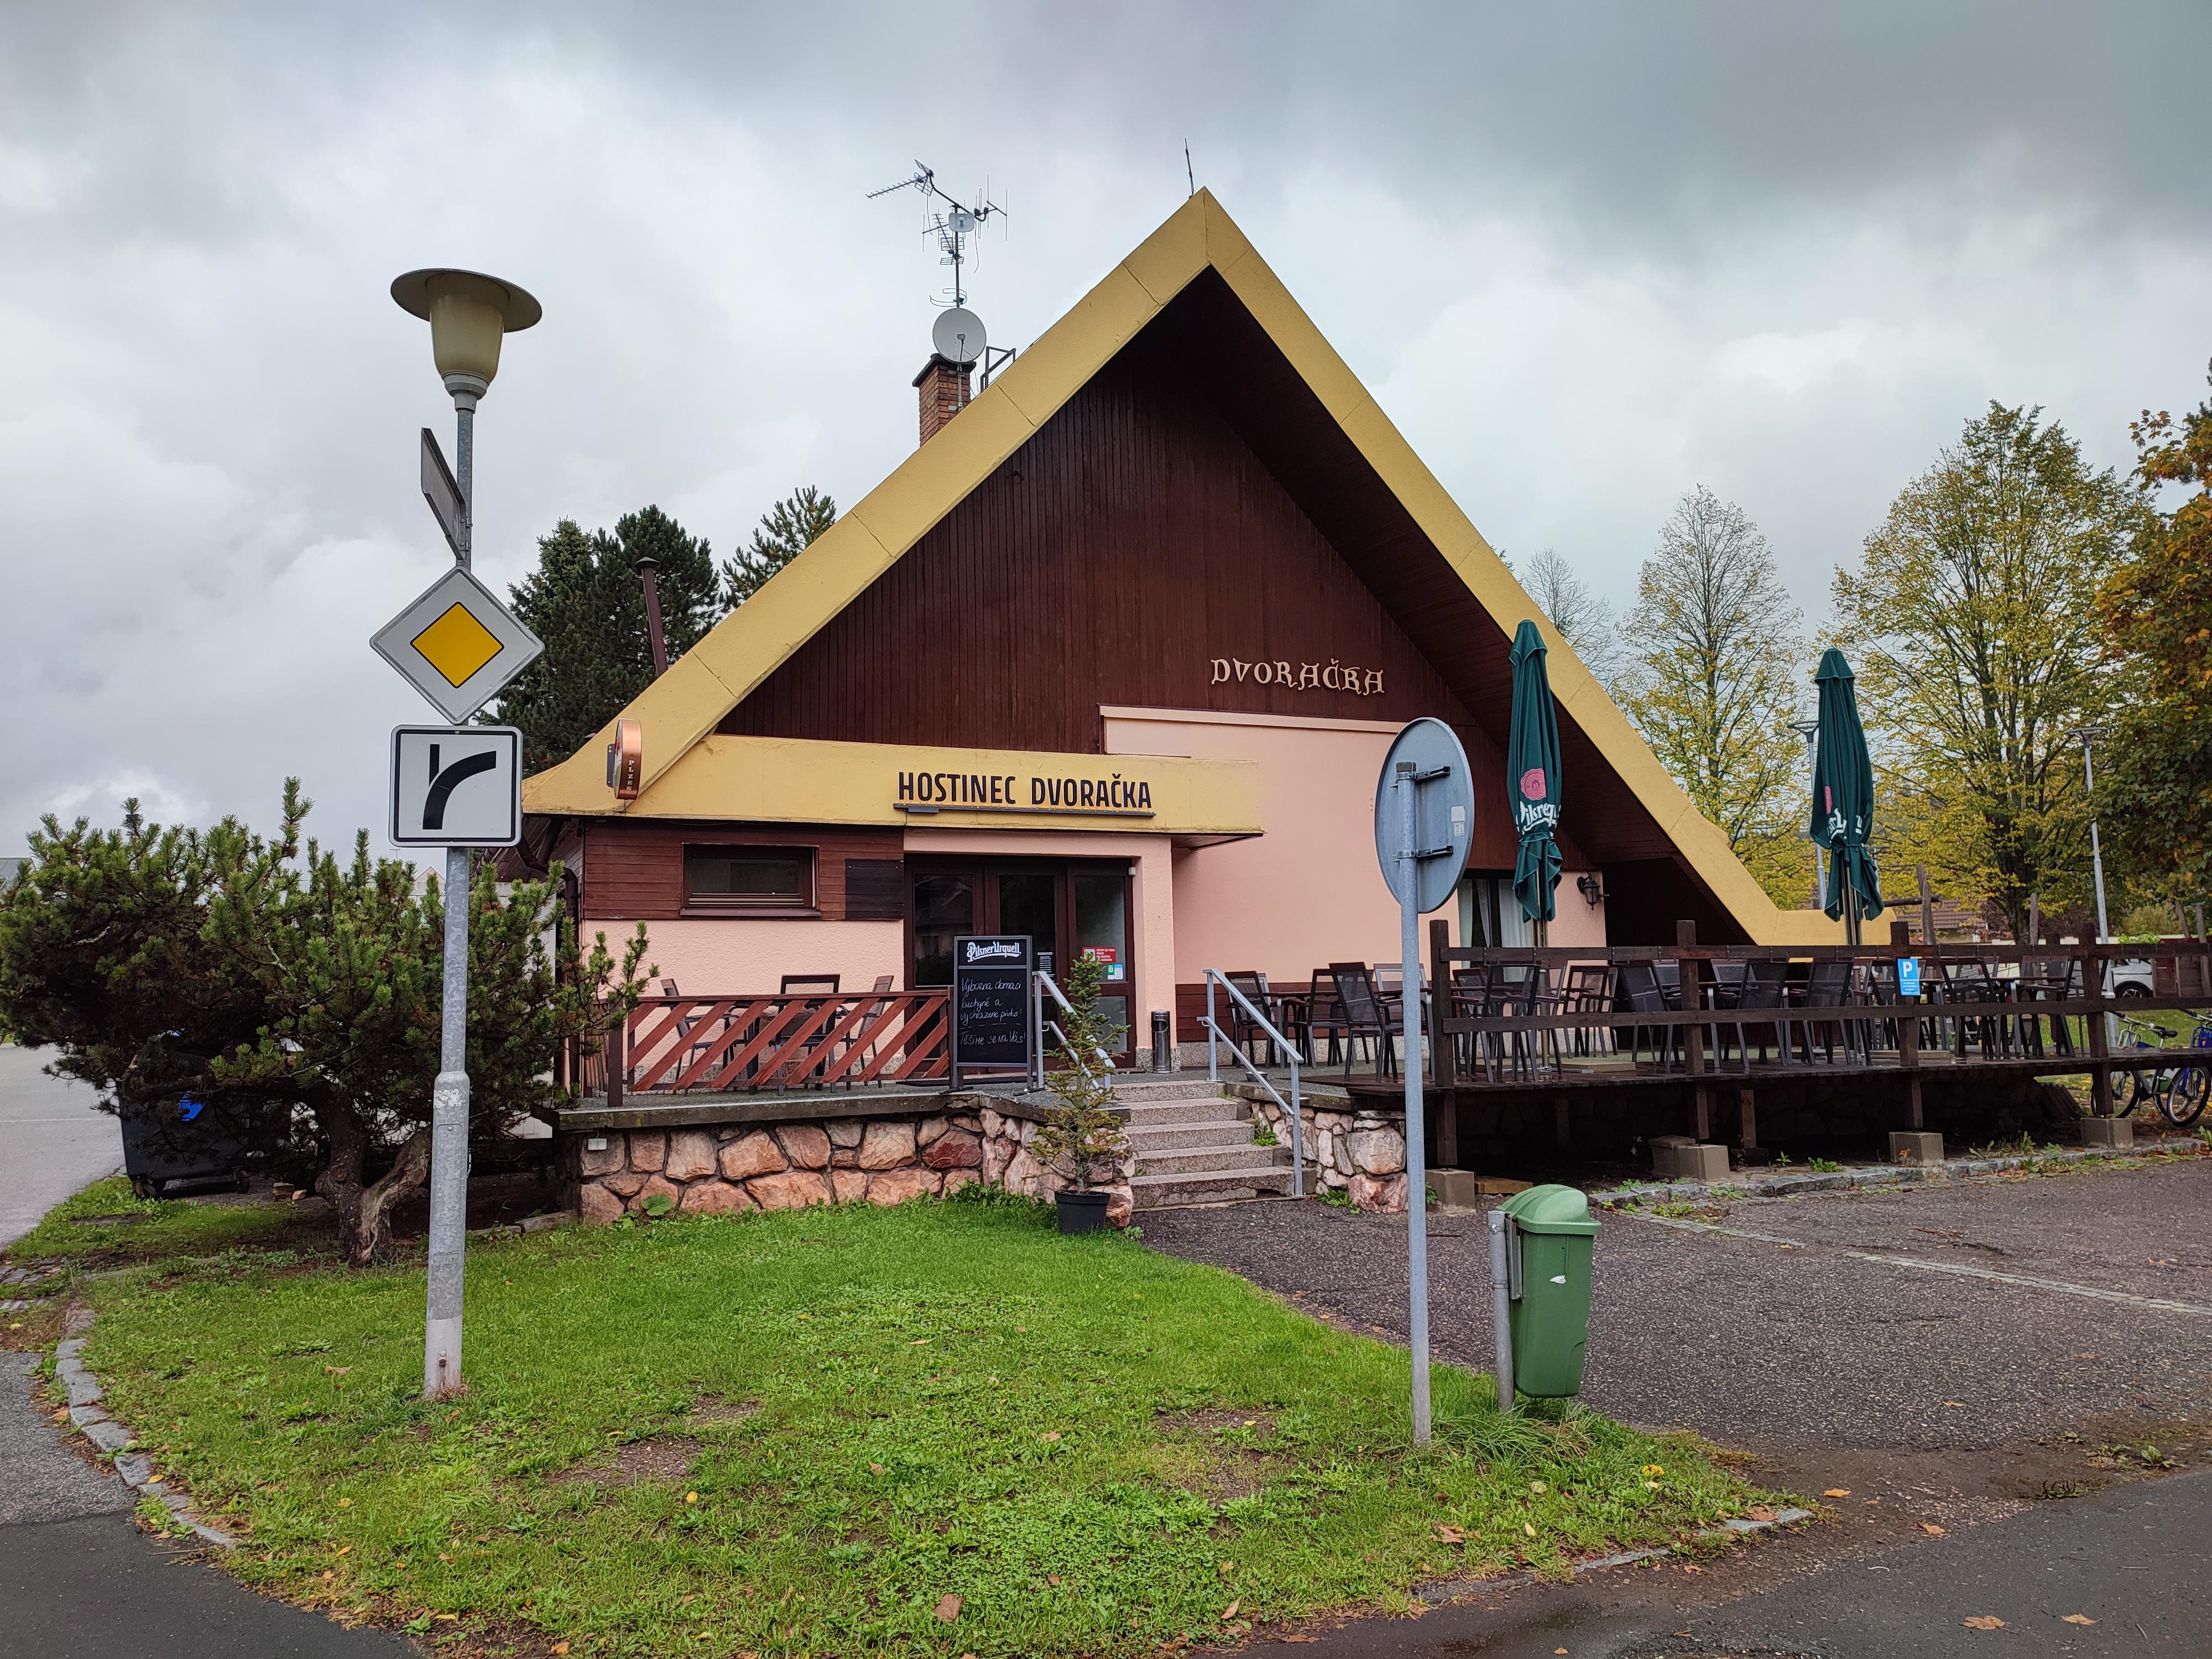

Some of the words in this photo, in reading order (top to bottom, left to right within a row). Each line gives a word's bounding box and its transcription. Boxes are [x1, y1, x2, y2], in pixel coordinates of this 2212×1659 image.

[1211, 658, 1385, 696] DVORAČKA
[899, 771, 1016, 805] HOSTINEC
[1031, 773, 1152, 808] DVORAČKA
[967, 942, 994, 962] Pilsner
[993, 941, 1021, 958] Urquell
[1902, 961, 1913, 978] P
[987, 1035, 997, 1044] se
